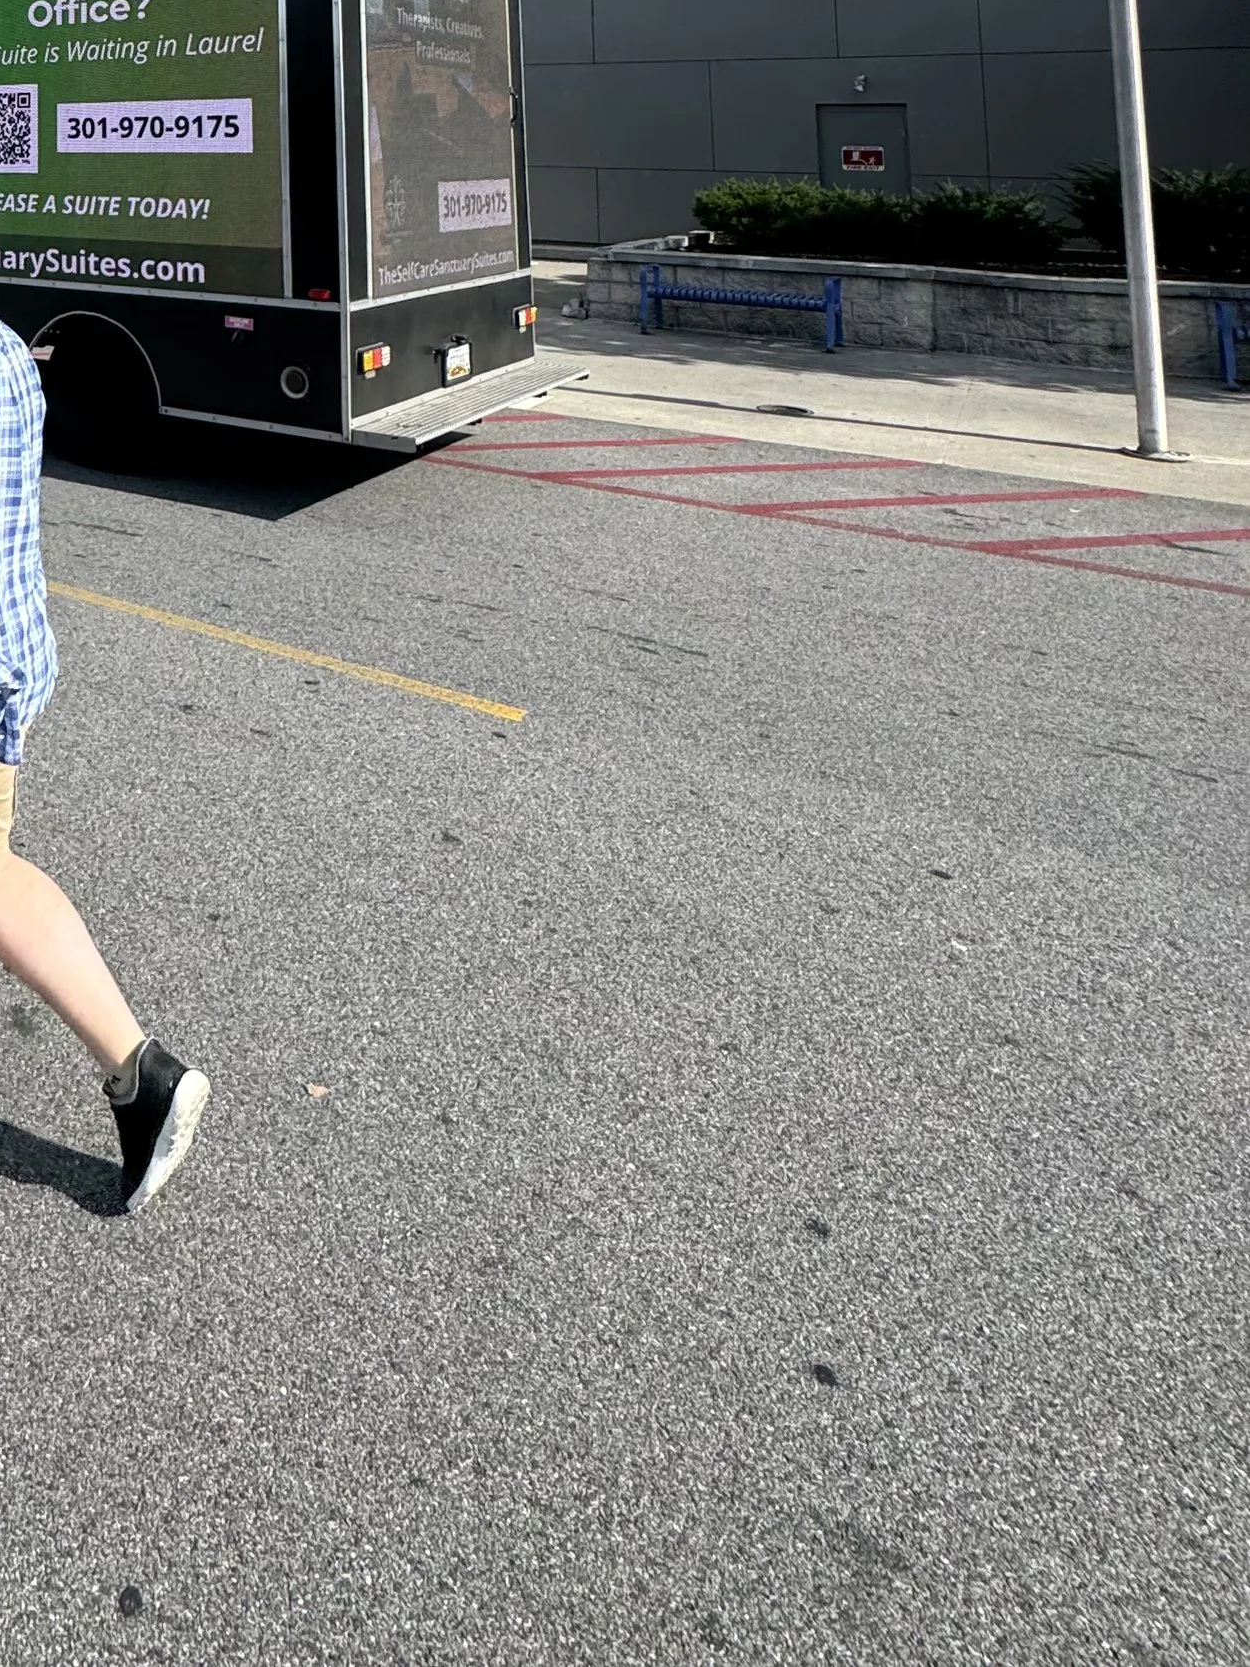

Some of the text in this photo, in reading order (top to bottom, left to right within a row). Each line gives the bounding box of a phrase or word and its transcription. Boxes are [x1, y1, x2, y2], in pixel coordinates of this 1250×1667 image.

[44, 42, 60, 64] is
[67, 38, 151, 65] Waiting
[156, 35, 177, 58] in
[185, 27, 265, 57] Laurel
[67, 115, 240, 139] 301-970-9175
[42, 194, 57, 214] A
[62, 194, 122, 216] SUITE
[127, 197, 211, 220] TODAY!
[443, 191, 508, 219] 301-970-9175
[378, 250, 515, 287] TheSelfCareSanctuarySuites.com
